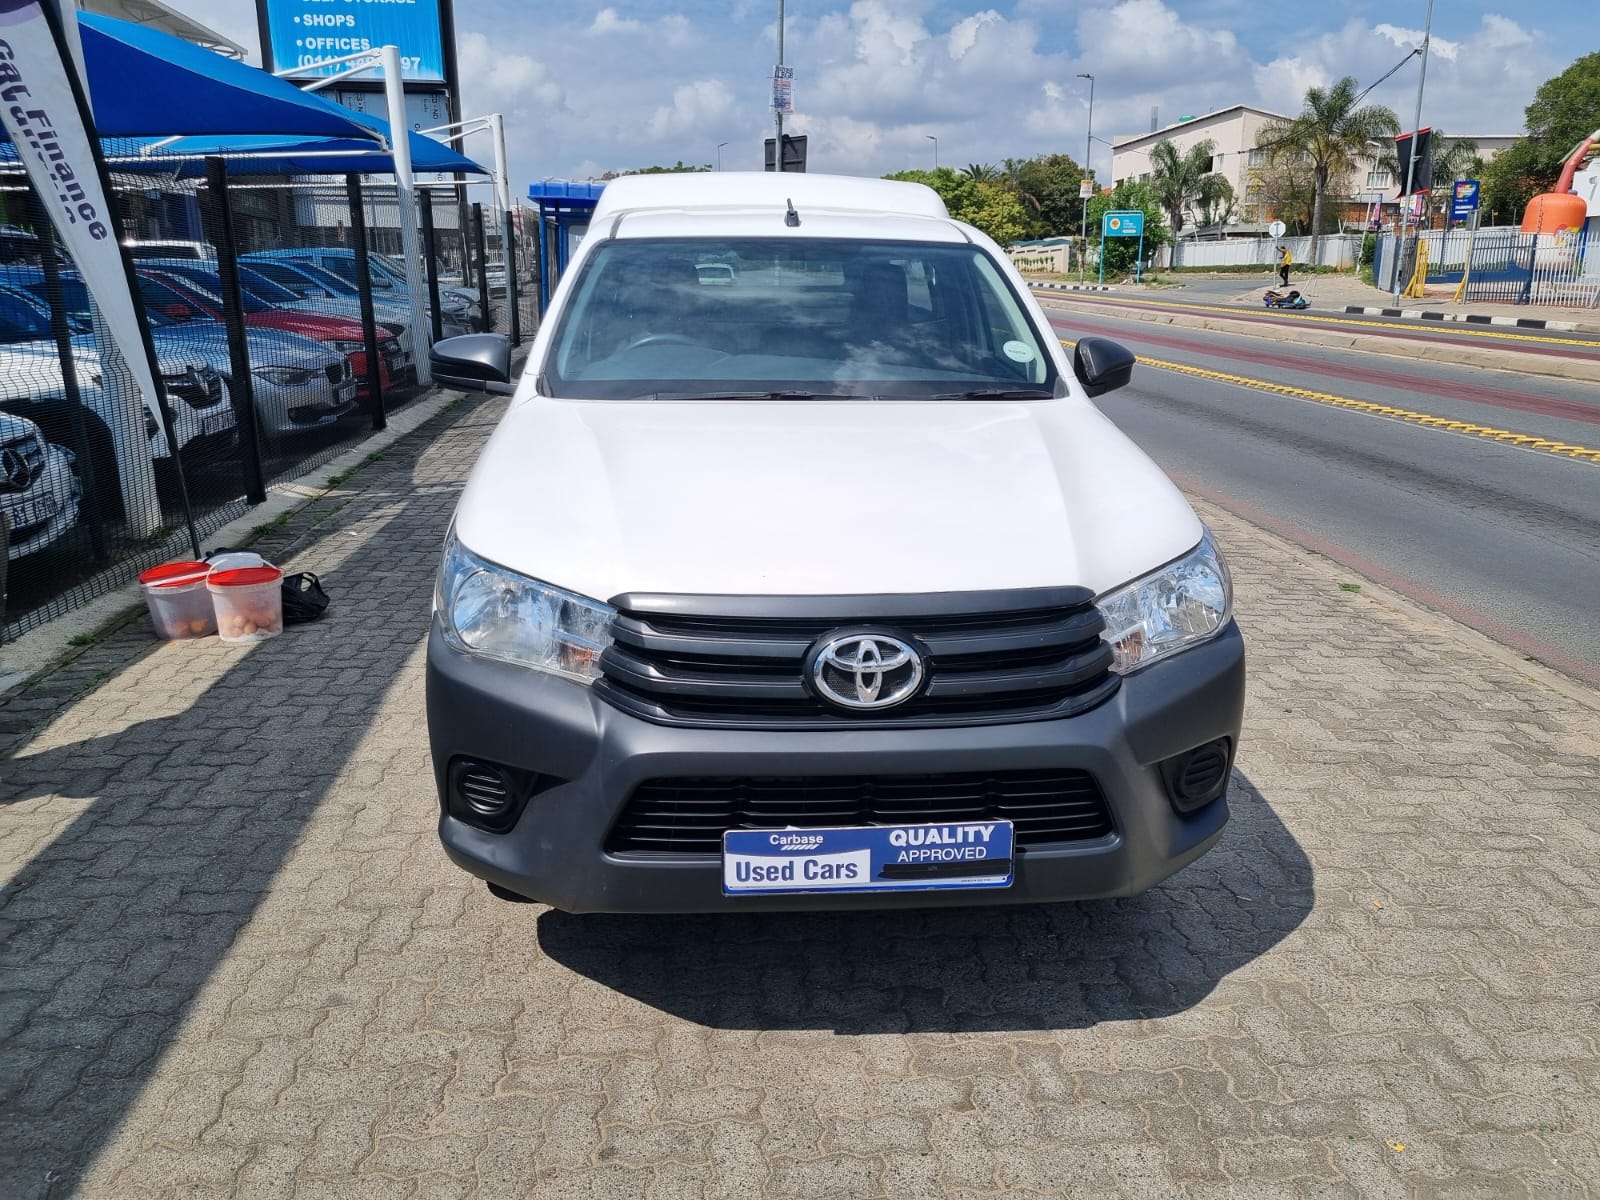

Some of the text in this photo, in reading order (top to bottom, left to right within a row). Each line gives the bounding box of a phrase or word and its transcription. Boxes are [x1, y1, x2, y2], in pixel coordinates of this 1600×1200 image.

[303, 14, 355, 27] SHOPS
[305, 37, 370, 50] OFFICES
[26, 109, 107, 241] Finance
[769, 834, 824, 845] Carbase
[889, 825, 996, 847] QUALITY
[897, 846, 987, 863] APPROVED
[736, 859, 859, 882] Used Cars
